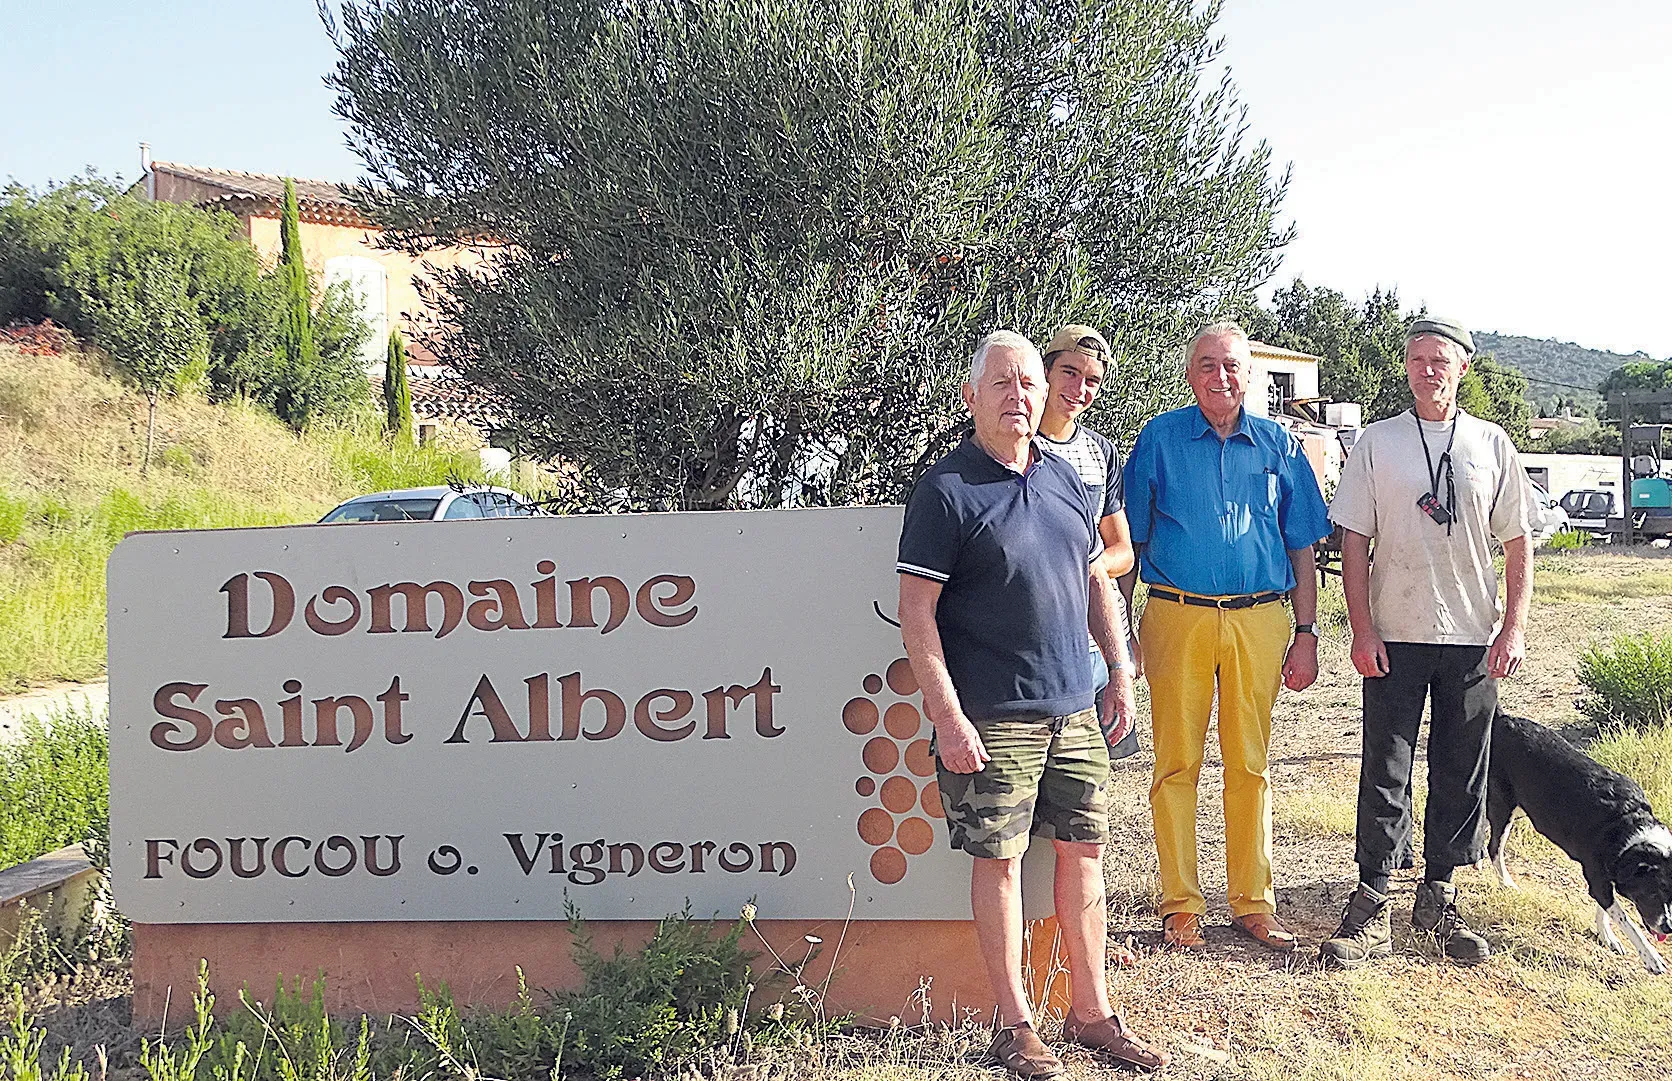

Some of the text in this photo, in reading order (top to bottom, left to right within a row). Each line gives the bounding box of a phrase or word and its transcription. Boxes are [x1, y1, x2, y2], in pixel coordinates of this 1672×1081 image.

[219, 559, 699, 639] Domaine
[149, 666, 786, 753] Saint Albert
[142, 834, 404, 879] FOUCOU
[503, 832, 797, 886] Vigneron
